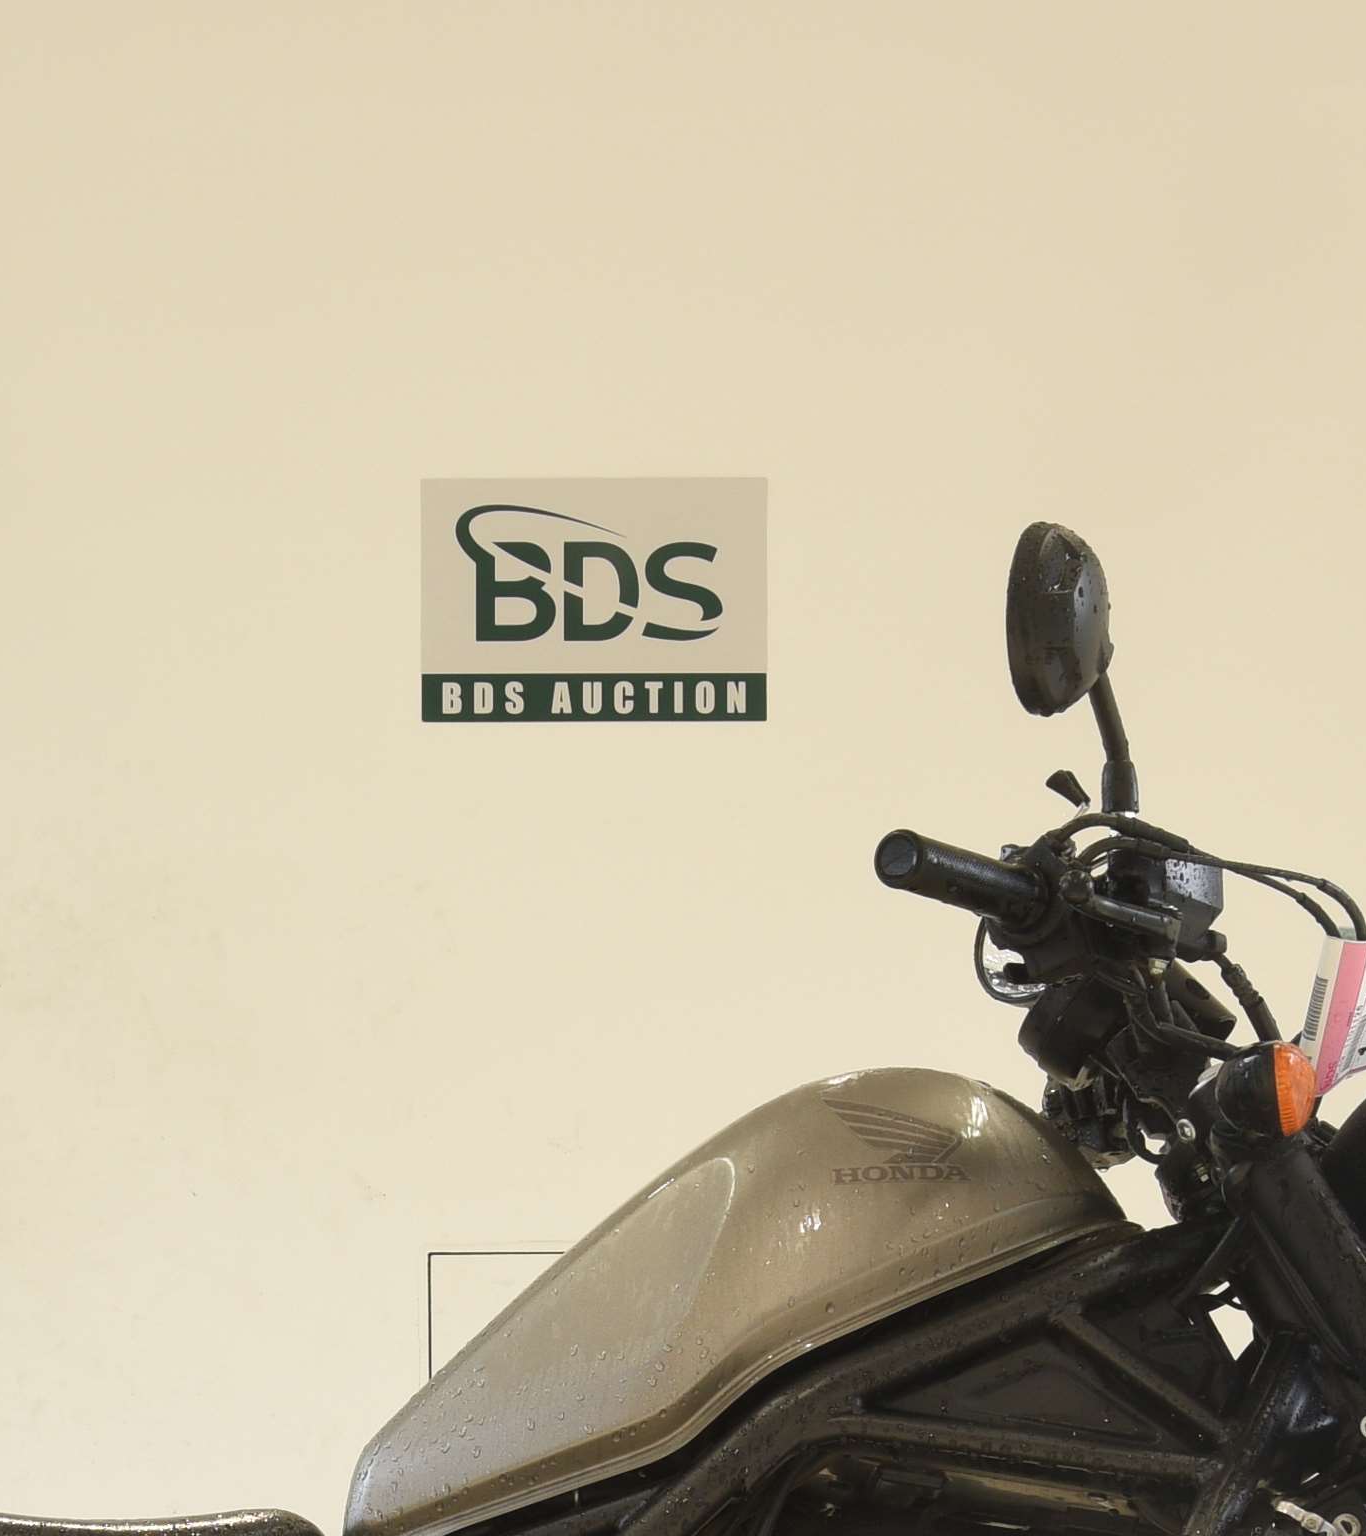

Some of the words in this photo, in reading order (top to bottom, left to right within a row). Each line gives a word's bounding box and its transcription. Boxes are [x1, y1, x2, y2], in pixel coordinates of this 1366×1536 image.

[455, 504, 724, 642] BDS
[441, 680, 526, 716] BDS
[550, 680, 748, 715] AUCTION
[832, 1164, 972, 1186] HONDA
